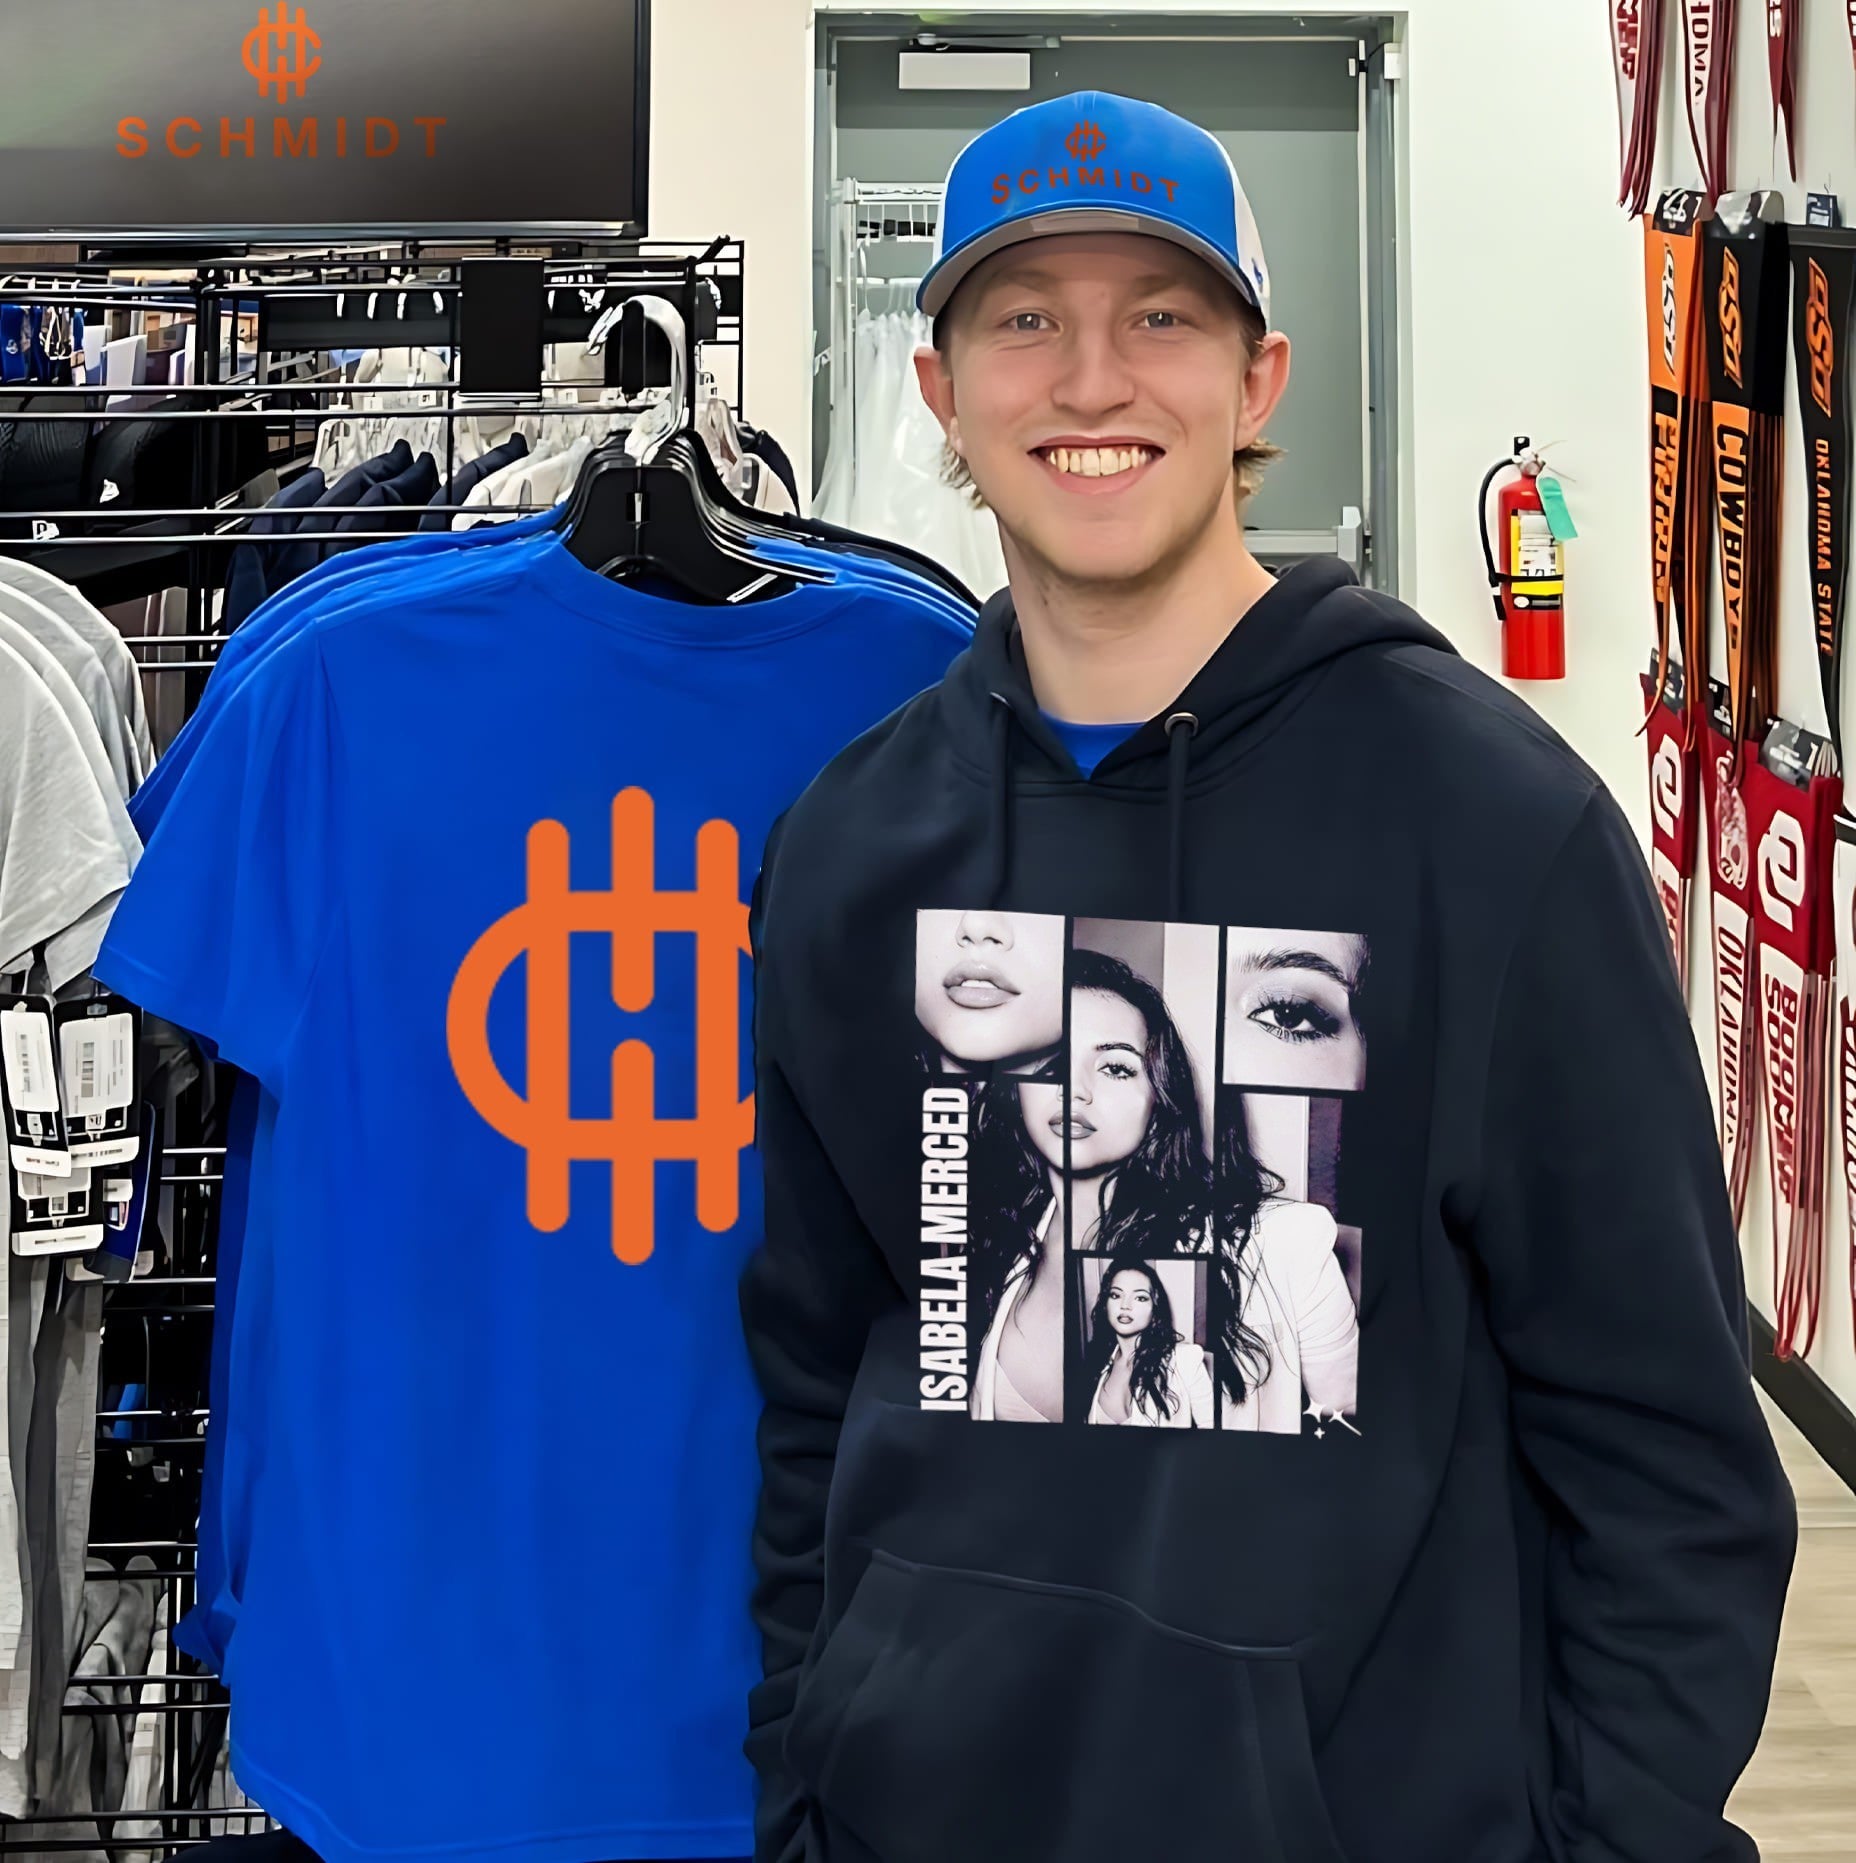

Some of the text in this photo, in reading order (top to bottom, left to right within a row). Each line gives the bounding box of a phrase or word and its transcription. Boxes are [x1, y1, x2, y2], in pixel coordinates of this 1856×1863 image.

[116, 117, 447, 159] SCHMIDT
[991, 166, 1179, 204] SCHMIDT
[1718, 925, 1745, 1145] OKLAHOMA
[919, 1086, 969, 1412] ISABELA MERCED
